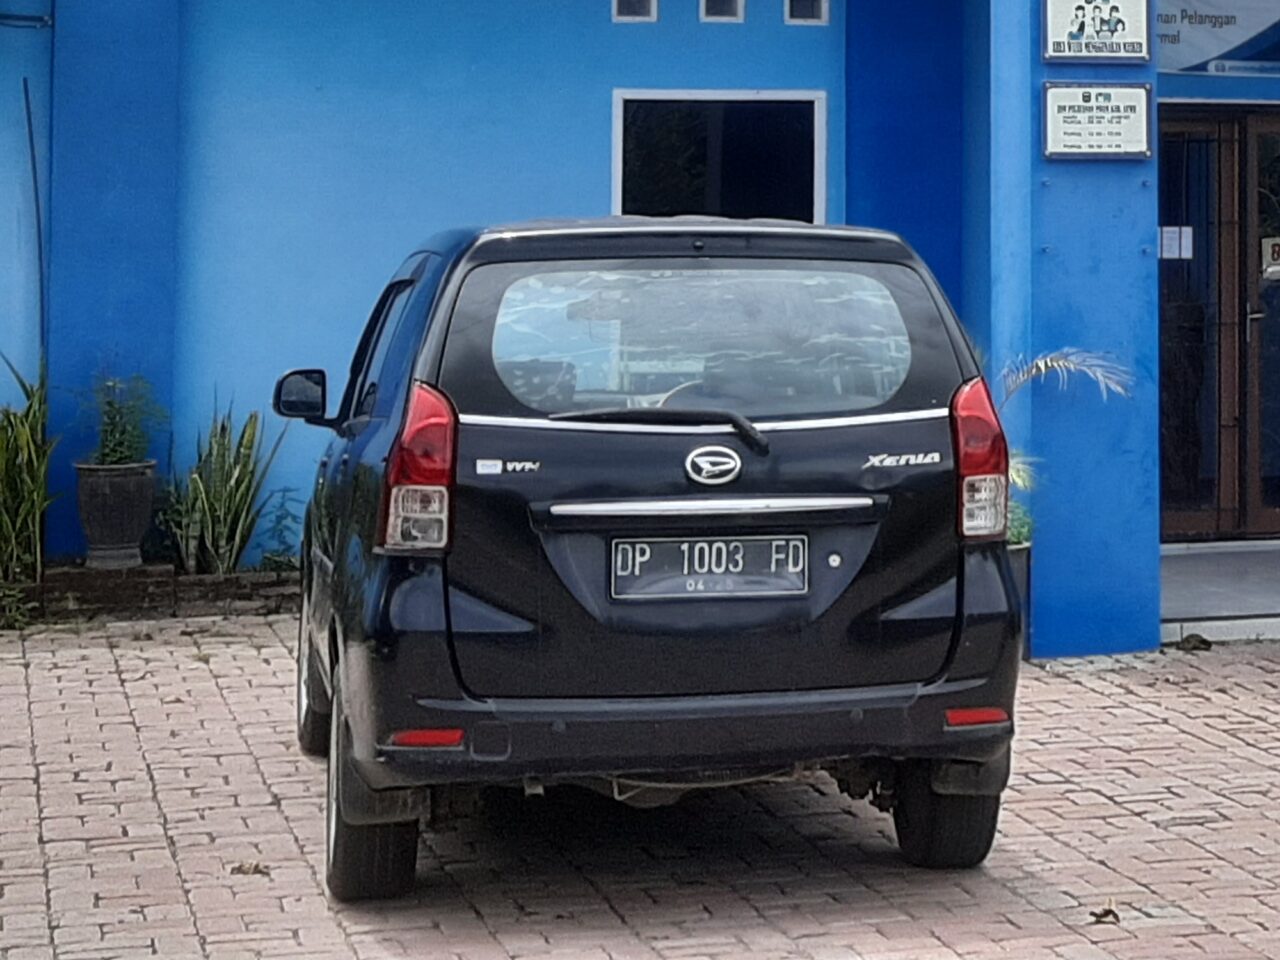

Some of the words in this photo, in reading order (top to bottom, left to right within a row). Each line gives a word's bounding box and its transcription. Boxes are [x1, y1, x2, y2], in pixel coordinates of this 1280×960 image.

[1181, 9, 1236, 28] Pelanggan
[616, 543, 650, 576] DP
[680, 541, 744, 575] 1003
[770, 540, 804, 573] FD
